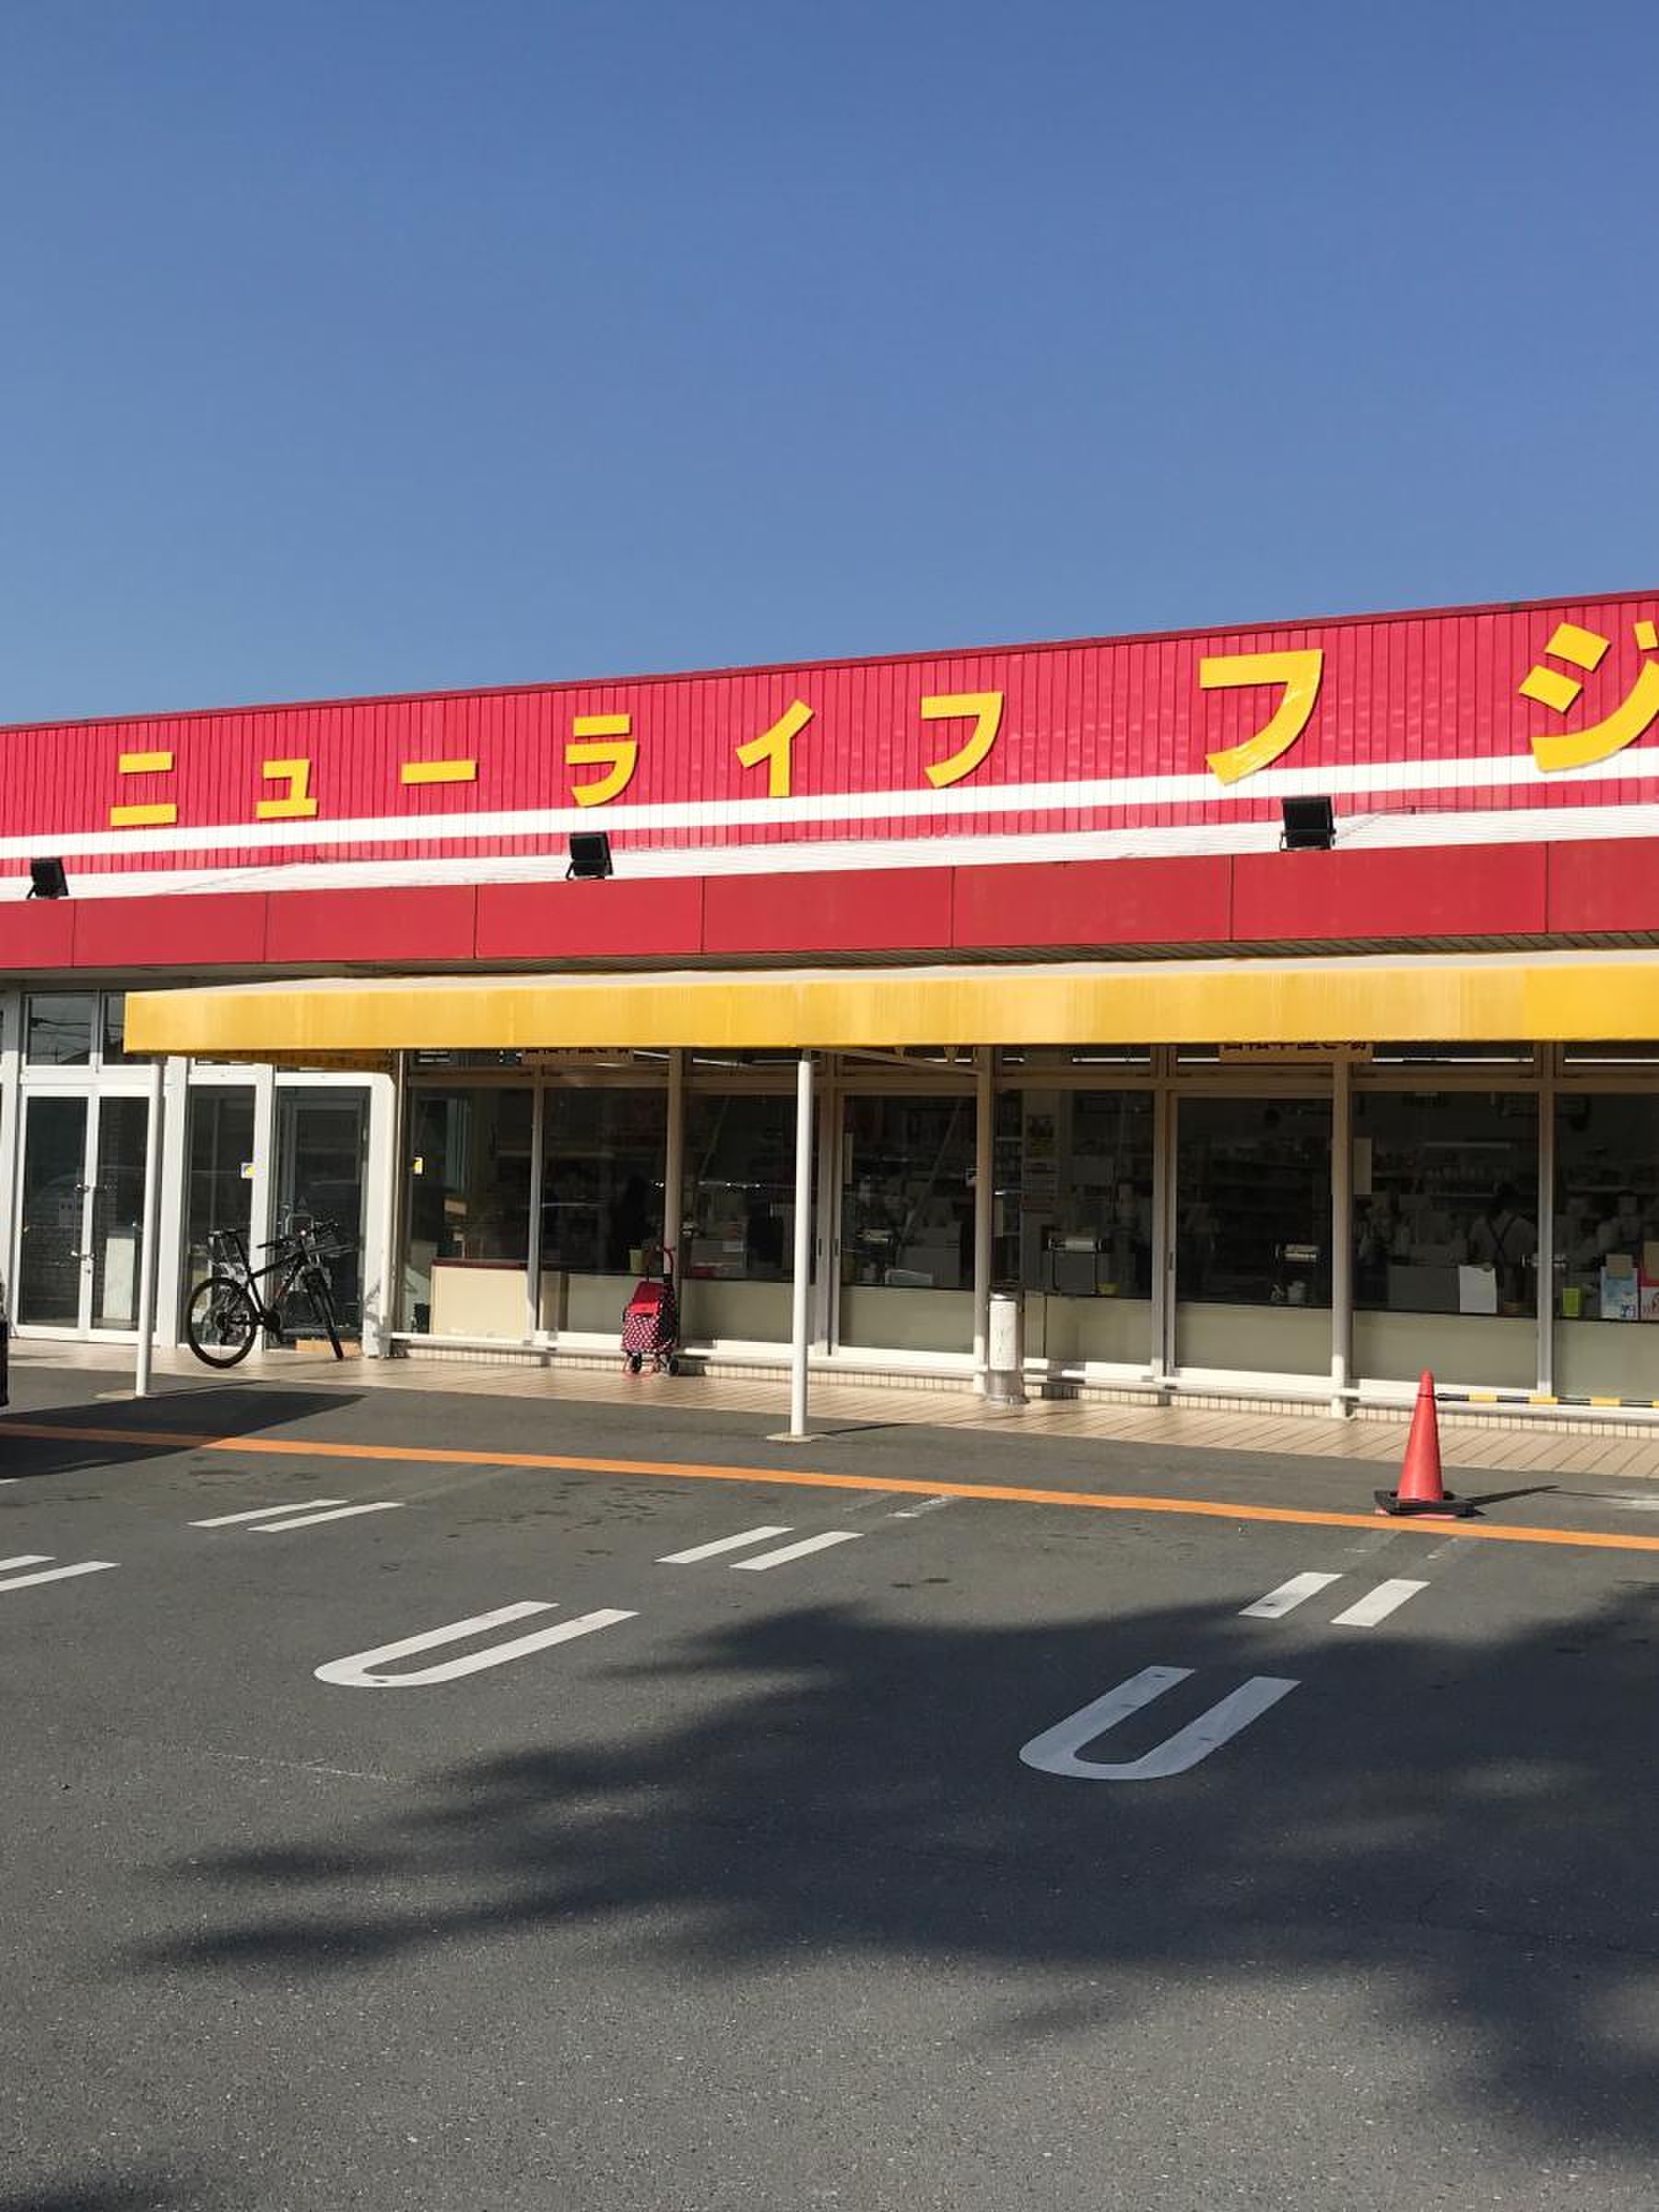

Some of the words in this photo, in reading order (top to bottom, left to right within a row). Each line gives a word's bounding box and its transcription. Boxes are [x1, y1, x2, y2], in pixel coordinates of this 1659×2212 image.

[110, 691, 1004, 827] ニューライフ
